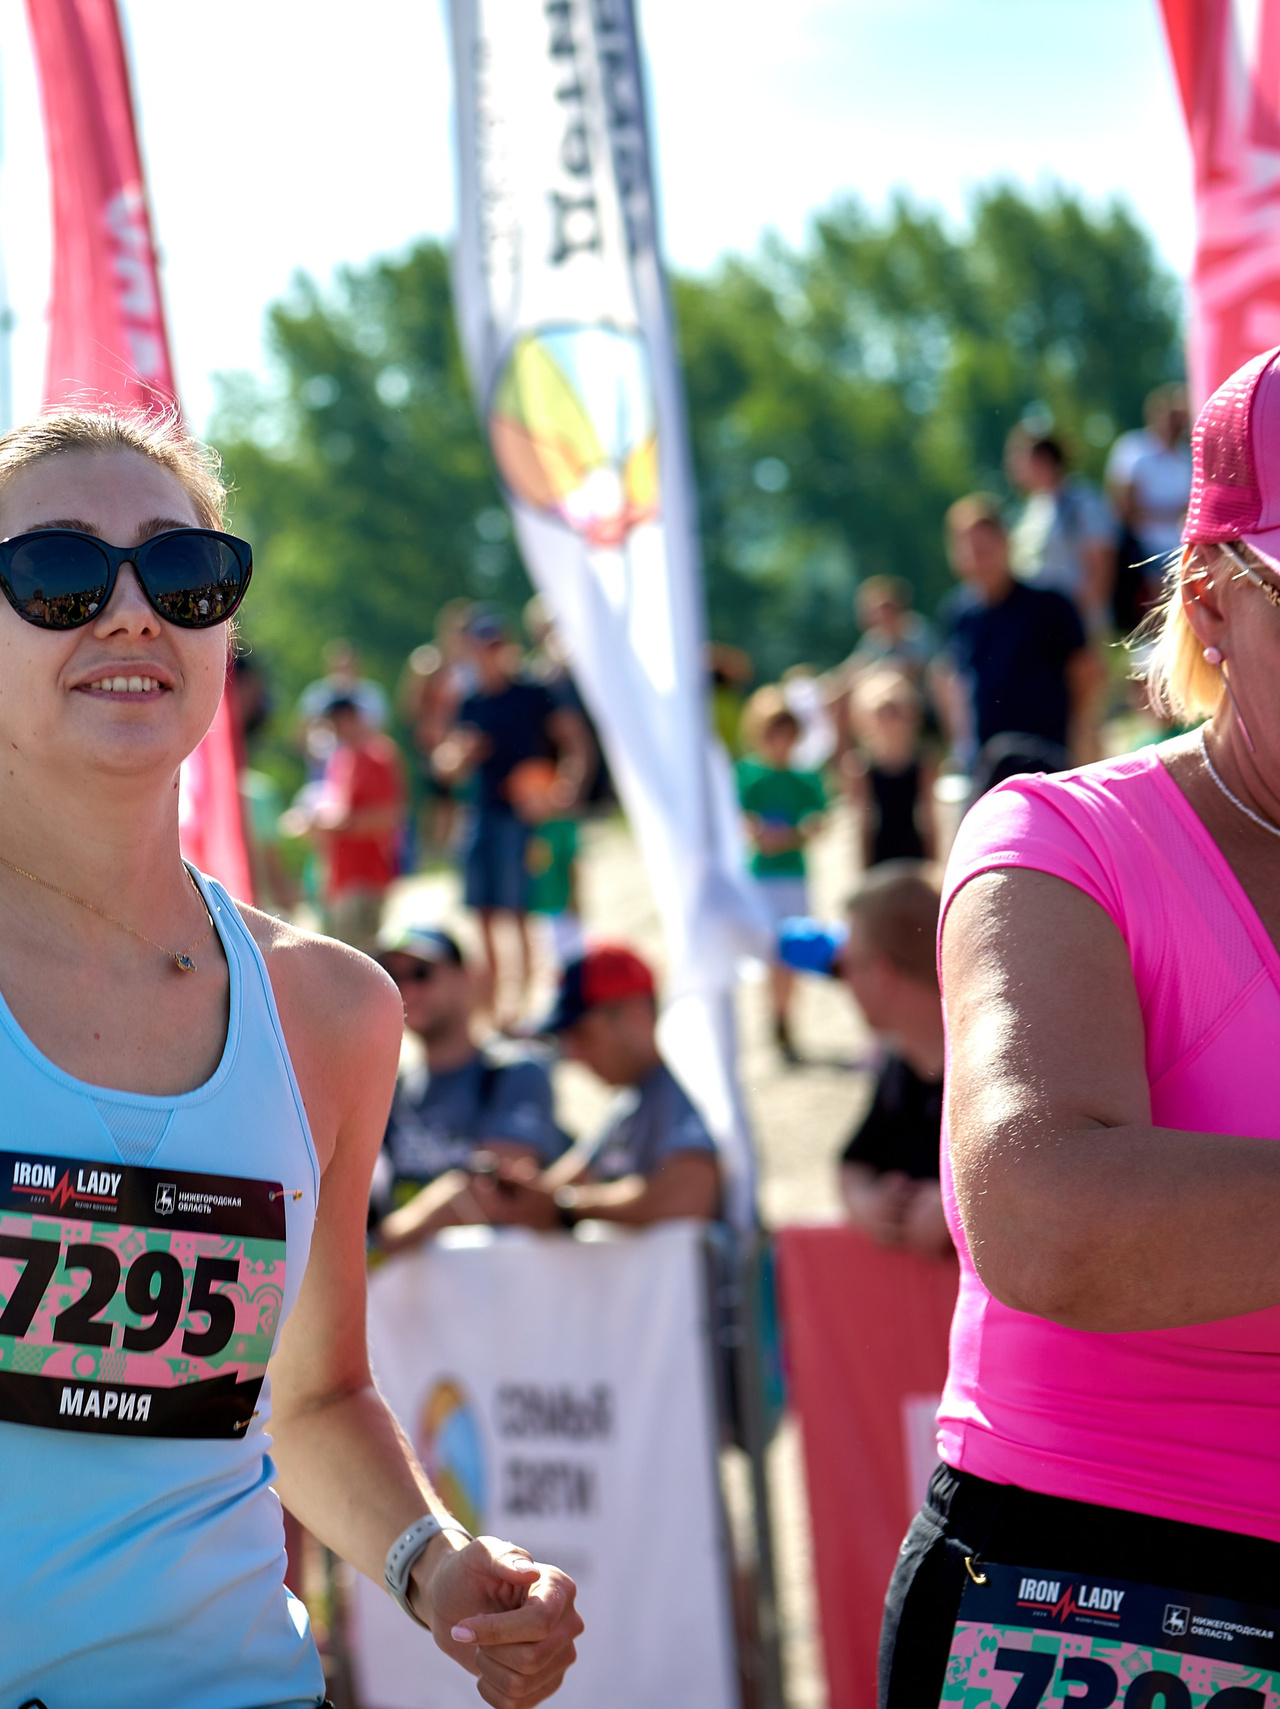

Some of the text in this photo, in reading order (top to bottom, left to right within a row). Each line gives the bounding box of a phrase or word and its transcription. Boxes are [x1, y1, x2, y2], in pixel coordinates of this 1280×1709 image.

[13, 1161, 122, 1197] IRON LADY
[178, 1191, 242, 1207] НИЖЕГОРОДСКАЯ
[178, 1201, 212, 1214] ОБЛАСТЬ
[58, 1387, 153, 1423] МАРИЯ
[1018, 1578, 1125, 1612] IRON LADY
[1190, 1626, 1234, 1641] ОБЛАСТЬ
[1192, 1616, 1275, 1639] НИЖЕГОРОДСКАЯ
